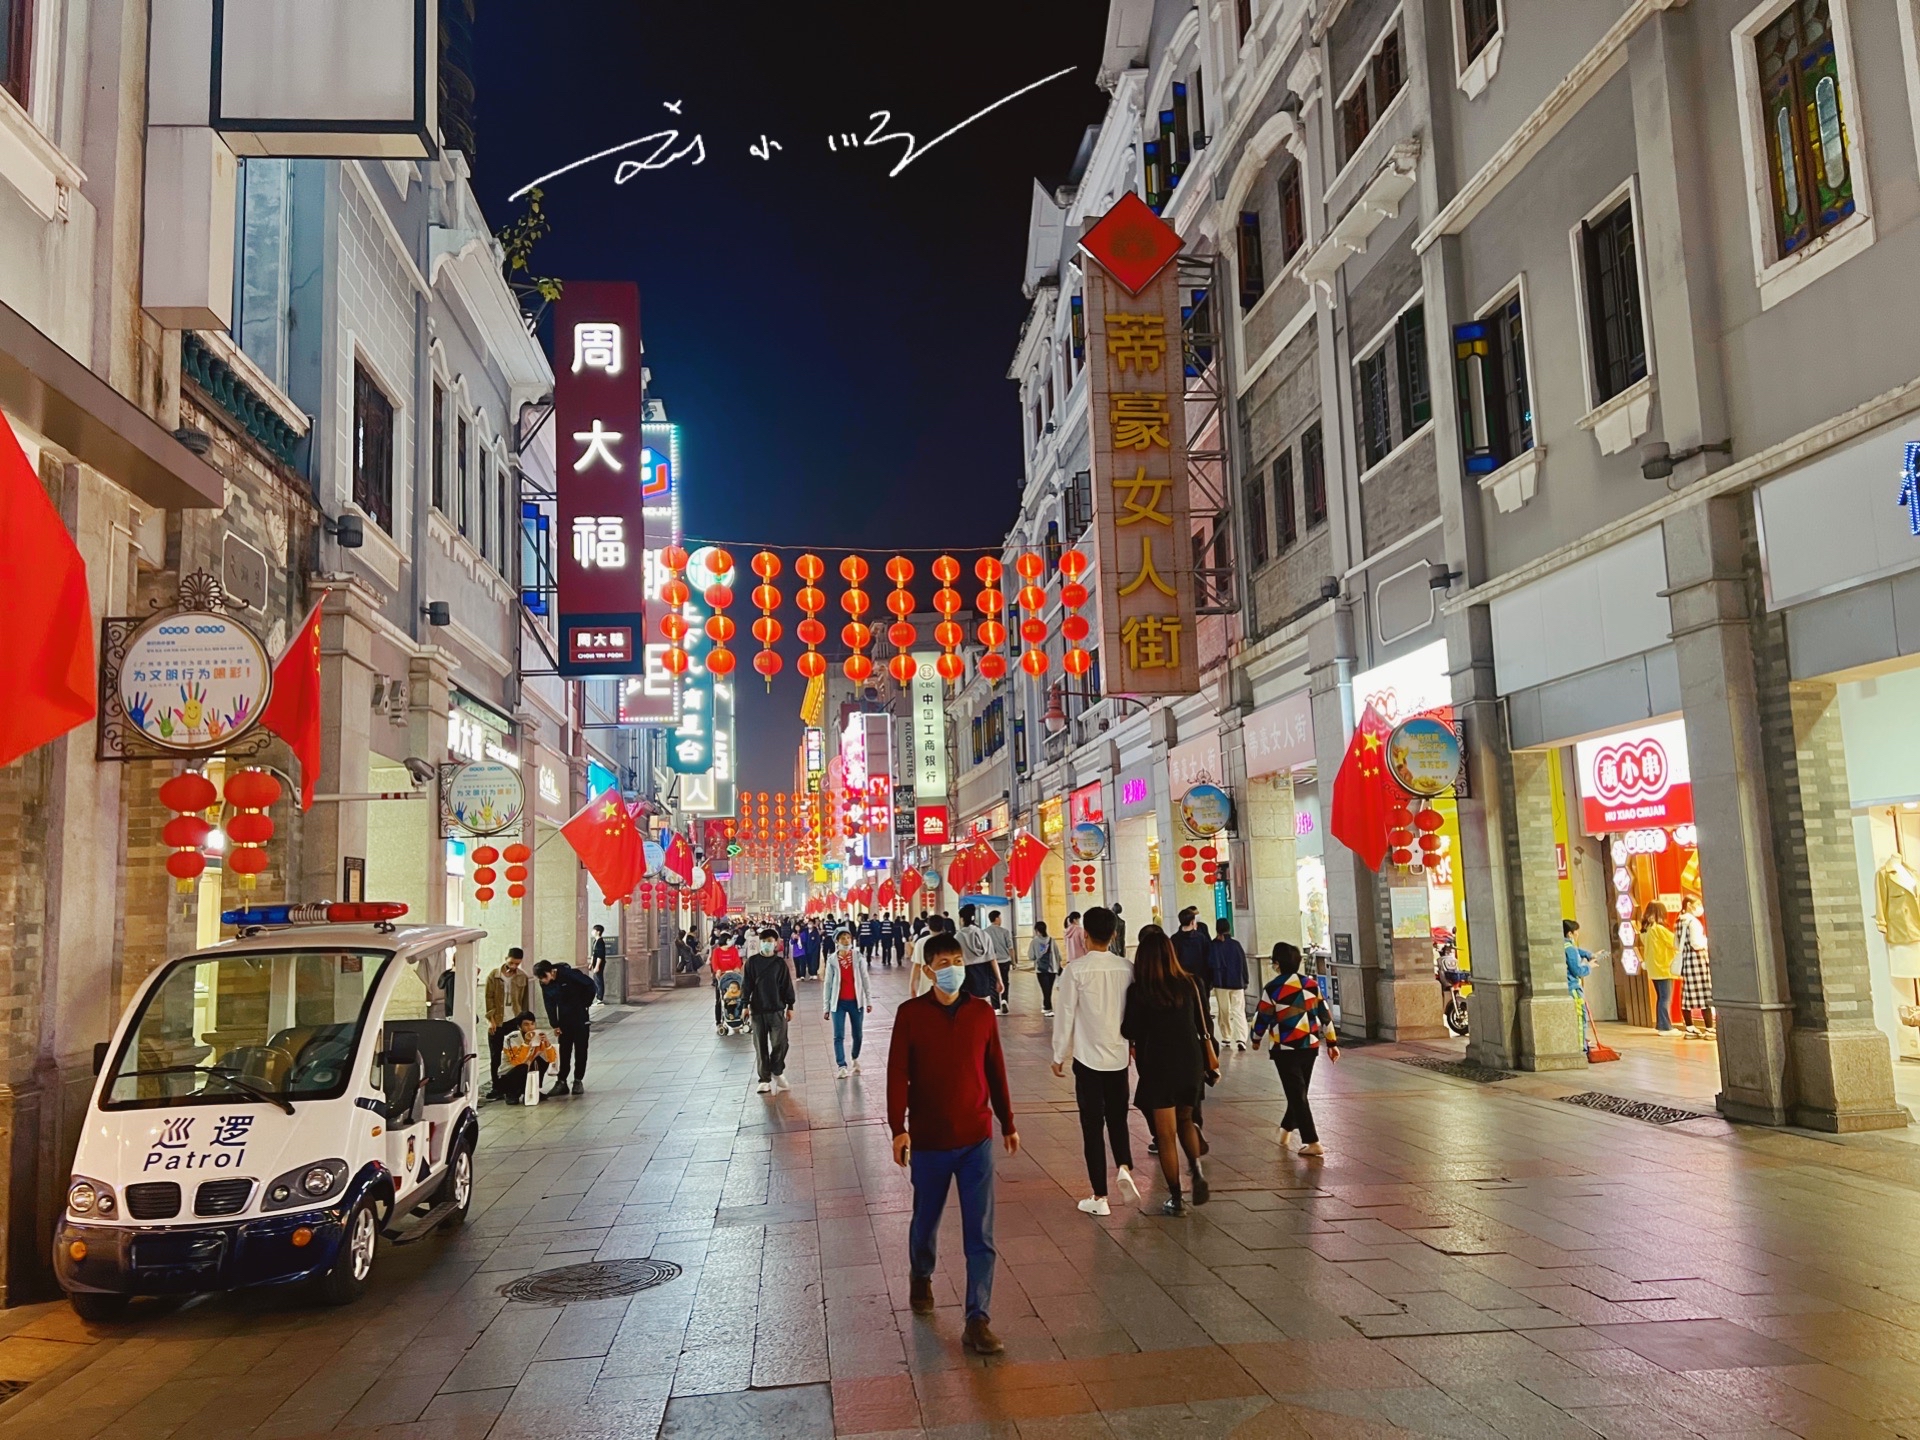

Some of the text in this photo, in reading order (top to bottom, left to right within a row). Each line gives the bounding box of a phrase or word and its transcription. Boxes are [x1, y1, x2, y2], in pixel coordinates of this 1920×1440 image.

[571, 322, 626, 569] 周大福
[577, 632, 624, 647] 周大福
[922, 693, 937, 783] 中国工商银行
[1600, 751, 1661, 788] 葫小串
[923, 816, 943, 828] 24h
[1604, 804, 1666, 823] HU XIAO CHUAN
[151, 1115, 255, 1150] 巡逻
[143, 1148, 245, 1172] Patrol
